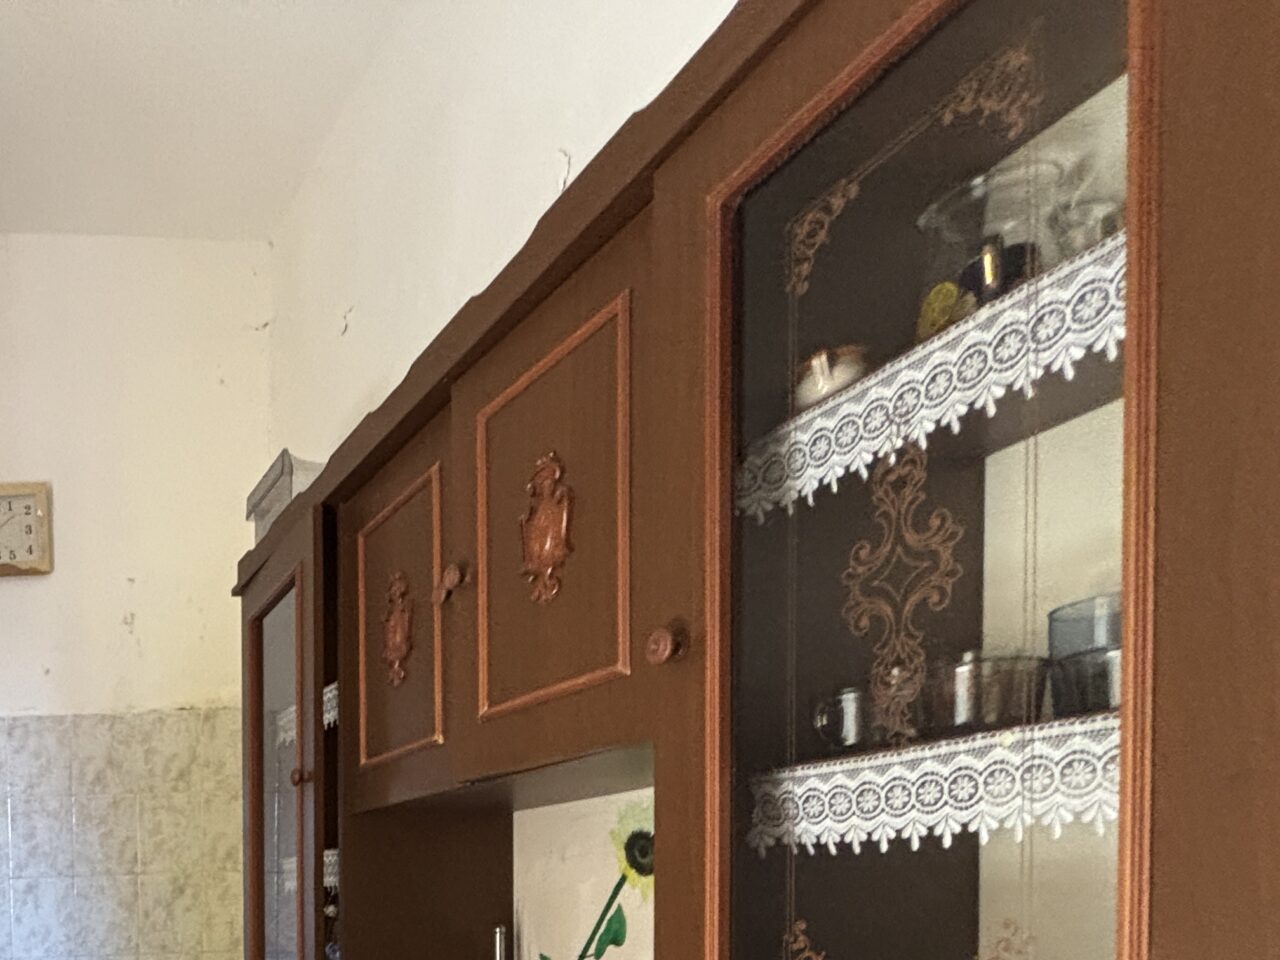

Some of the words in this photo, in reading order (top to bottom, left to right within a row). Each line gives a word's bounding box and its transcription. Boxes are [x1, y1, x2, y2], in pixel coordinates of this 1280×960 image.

[24, 505, 31, 515] 2
[25, 525, 32, 535] 3
[26, 545, 33, 555] 4
[9, 551, 17, 561] 5
